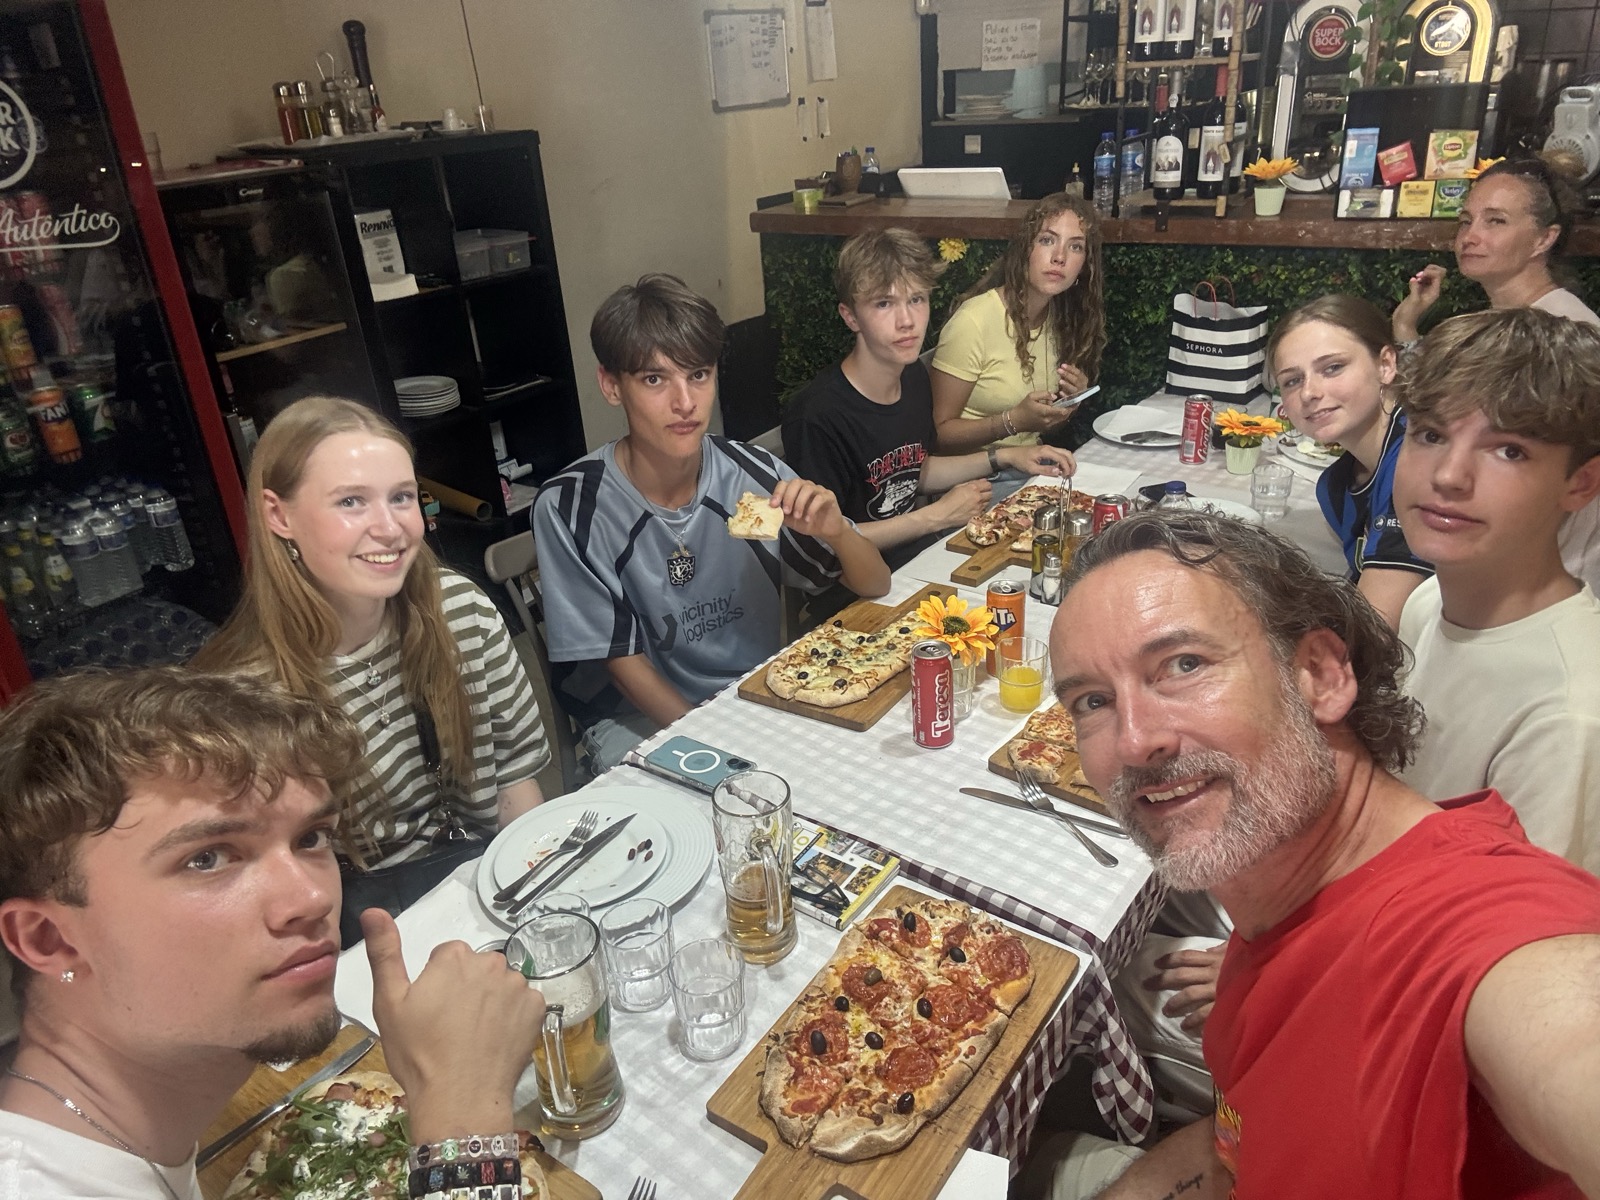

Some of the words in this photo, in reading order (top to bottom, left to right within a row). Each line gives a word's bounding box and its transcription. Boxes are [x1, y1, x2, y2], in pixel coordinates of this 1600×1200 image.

[1314, 36, 1342, 47] BOCK
[1186, 343, 1223, 354] SEPHORA
[1386, 518, 1402, 528] RES
[679, 593, 732, 626] vicinity
[682, 606, 745, 644] logistics
[931, 669, 951, 738] Teresa
